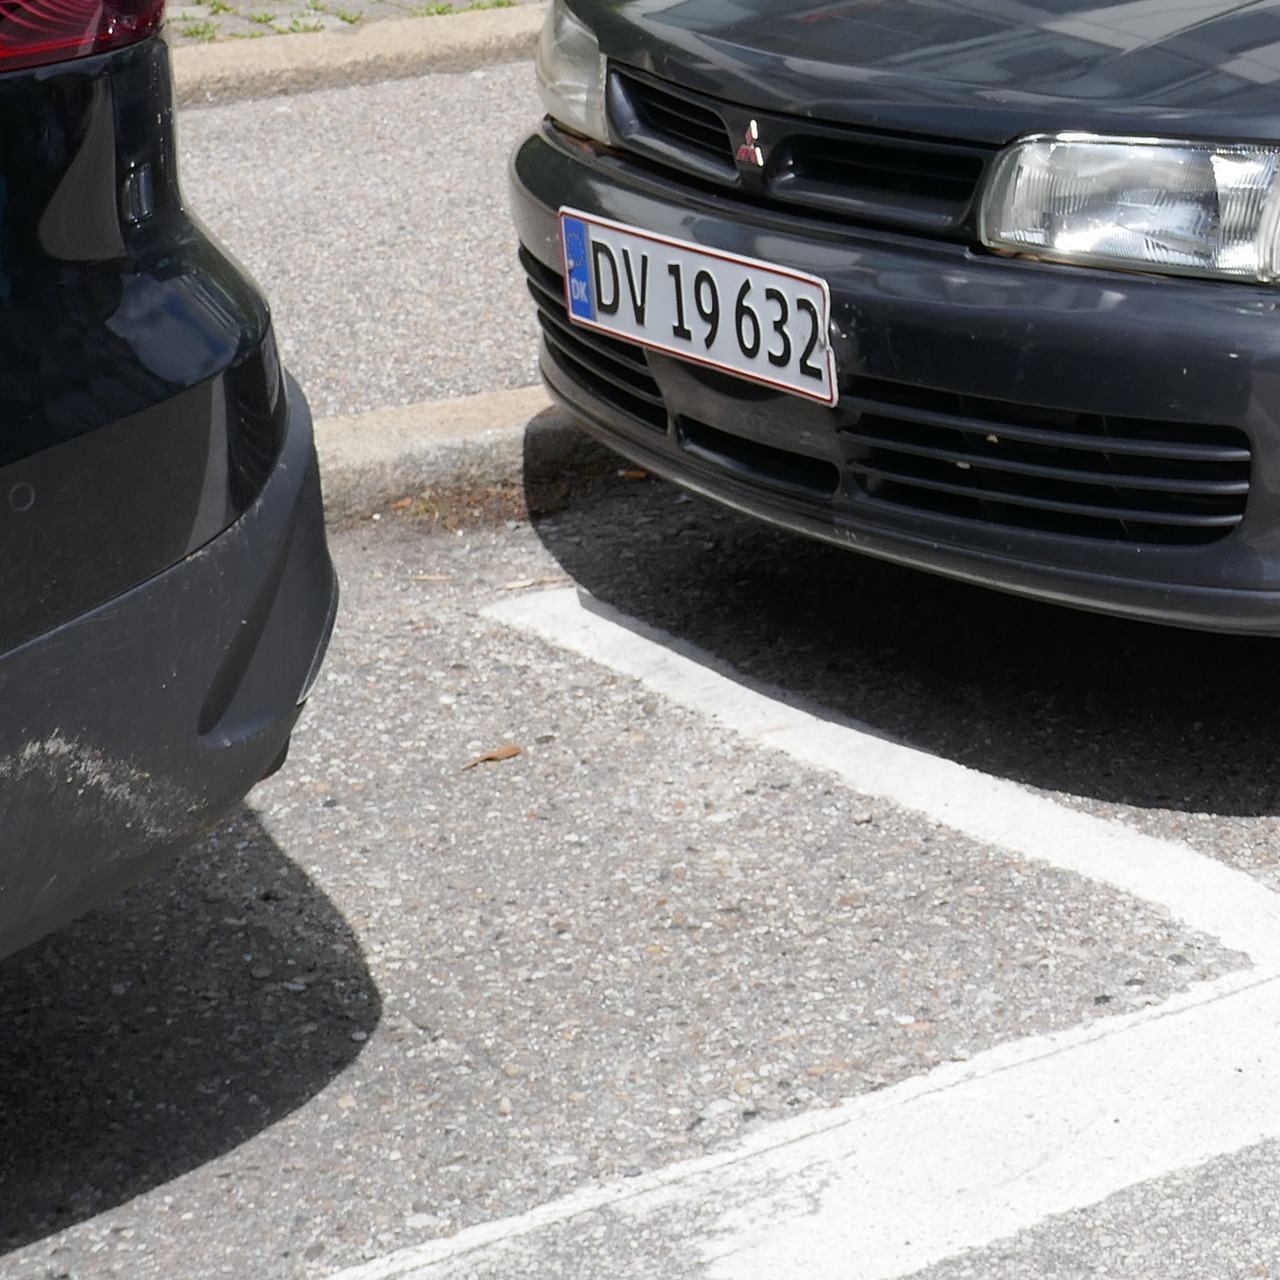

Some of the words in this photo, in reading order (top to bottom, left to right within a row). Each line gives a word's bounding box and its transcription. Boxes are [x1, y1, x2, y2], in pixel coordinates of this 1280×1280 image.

[570, 277, 588, 304] DK
[591, 239, 649, 328] DV
[667, 263, 721, 350] 19
[734, 277, 824, 382] 632
